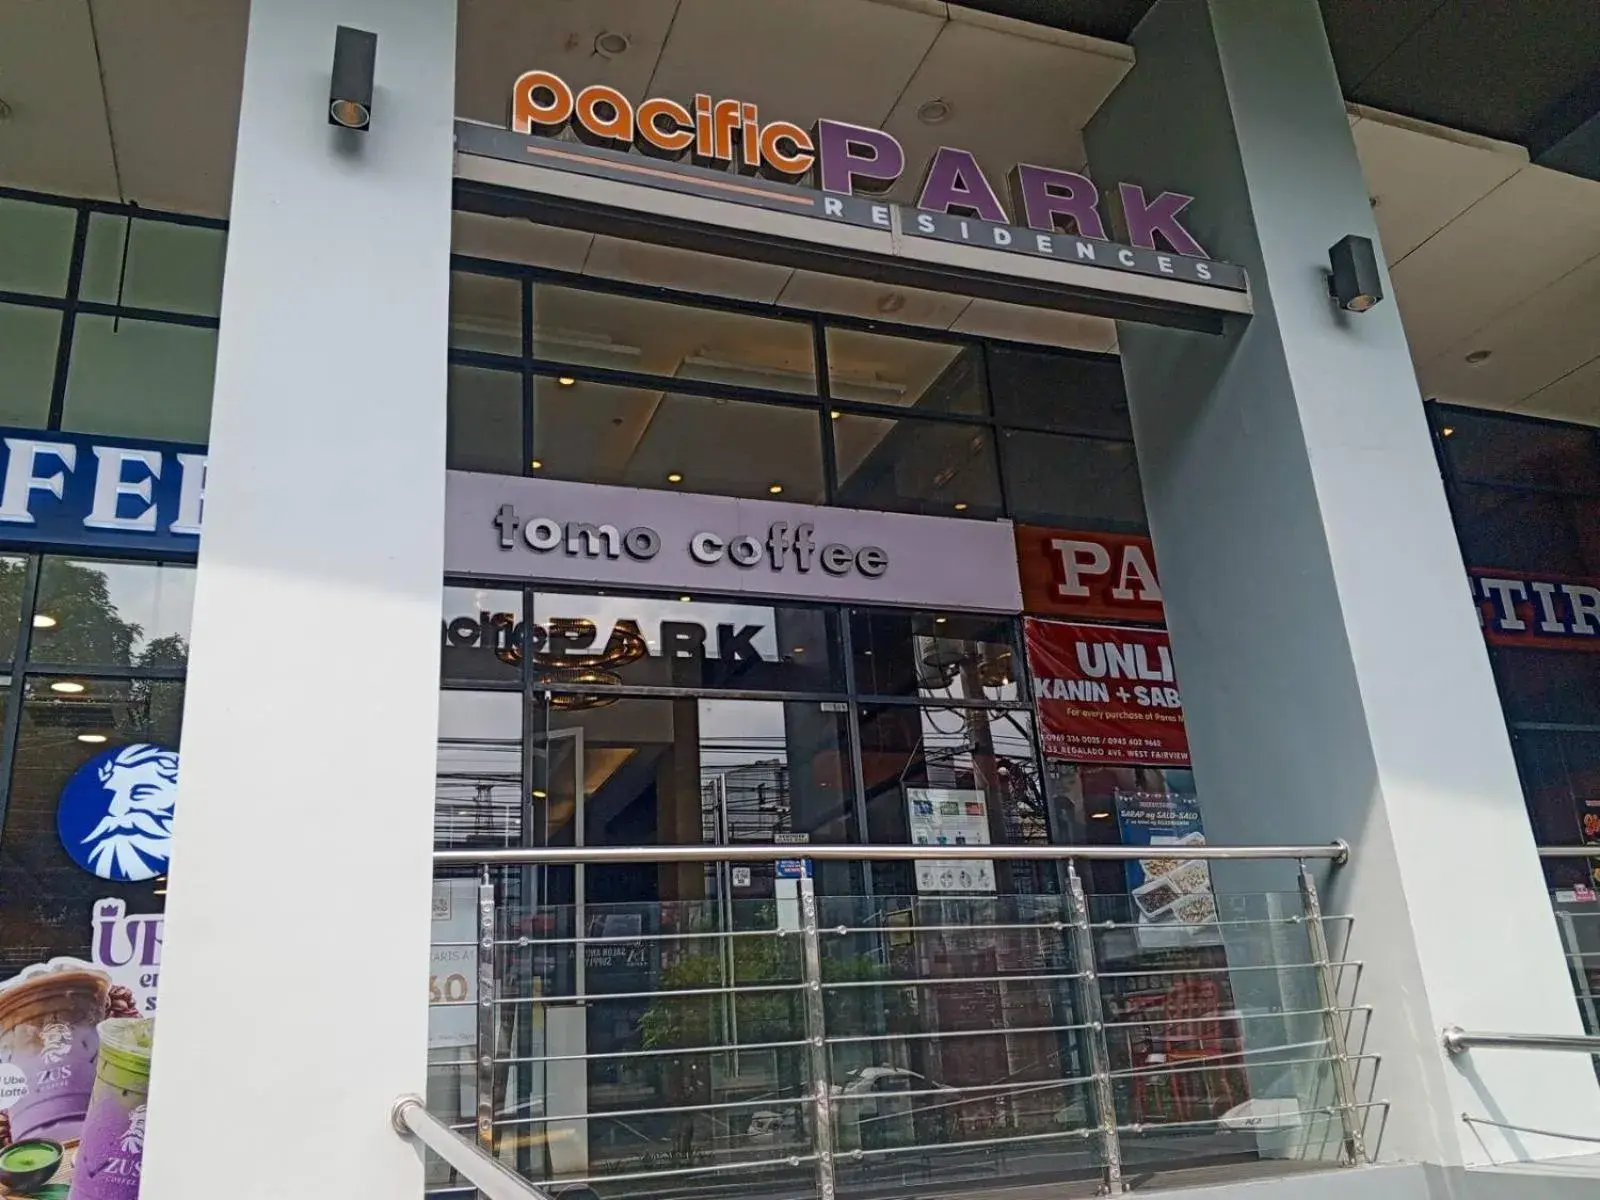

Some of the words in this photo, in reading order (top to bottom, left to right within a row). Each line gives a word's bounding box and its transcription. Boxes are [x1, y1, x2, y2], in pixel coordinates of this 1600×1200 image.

[511, 69, 815, 176] pacific
[816, 118, 1212, 259] PARK
[824, 197, 1212, 281] RESIDENCES
[495, 503, 662, 561] tomo
[690, 521, 889, 579] coffee
[1052, 538, 1163, 601] PA
[1468, 577, 1600, 635] TIR
[1075, 641, 1175, 683] UNLI
[1034, 677, 1110, 703] KANIN
[1133, 685, 1182, 709] SAB
[1126, 750, 1148, 758] WEST
[36, 1064, 72, 1084] ZUS
